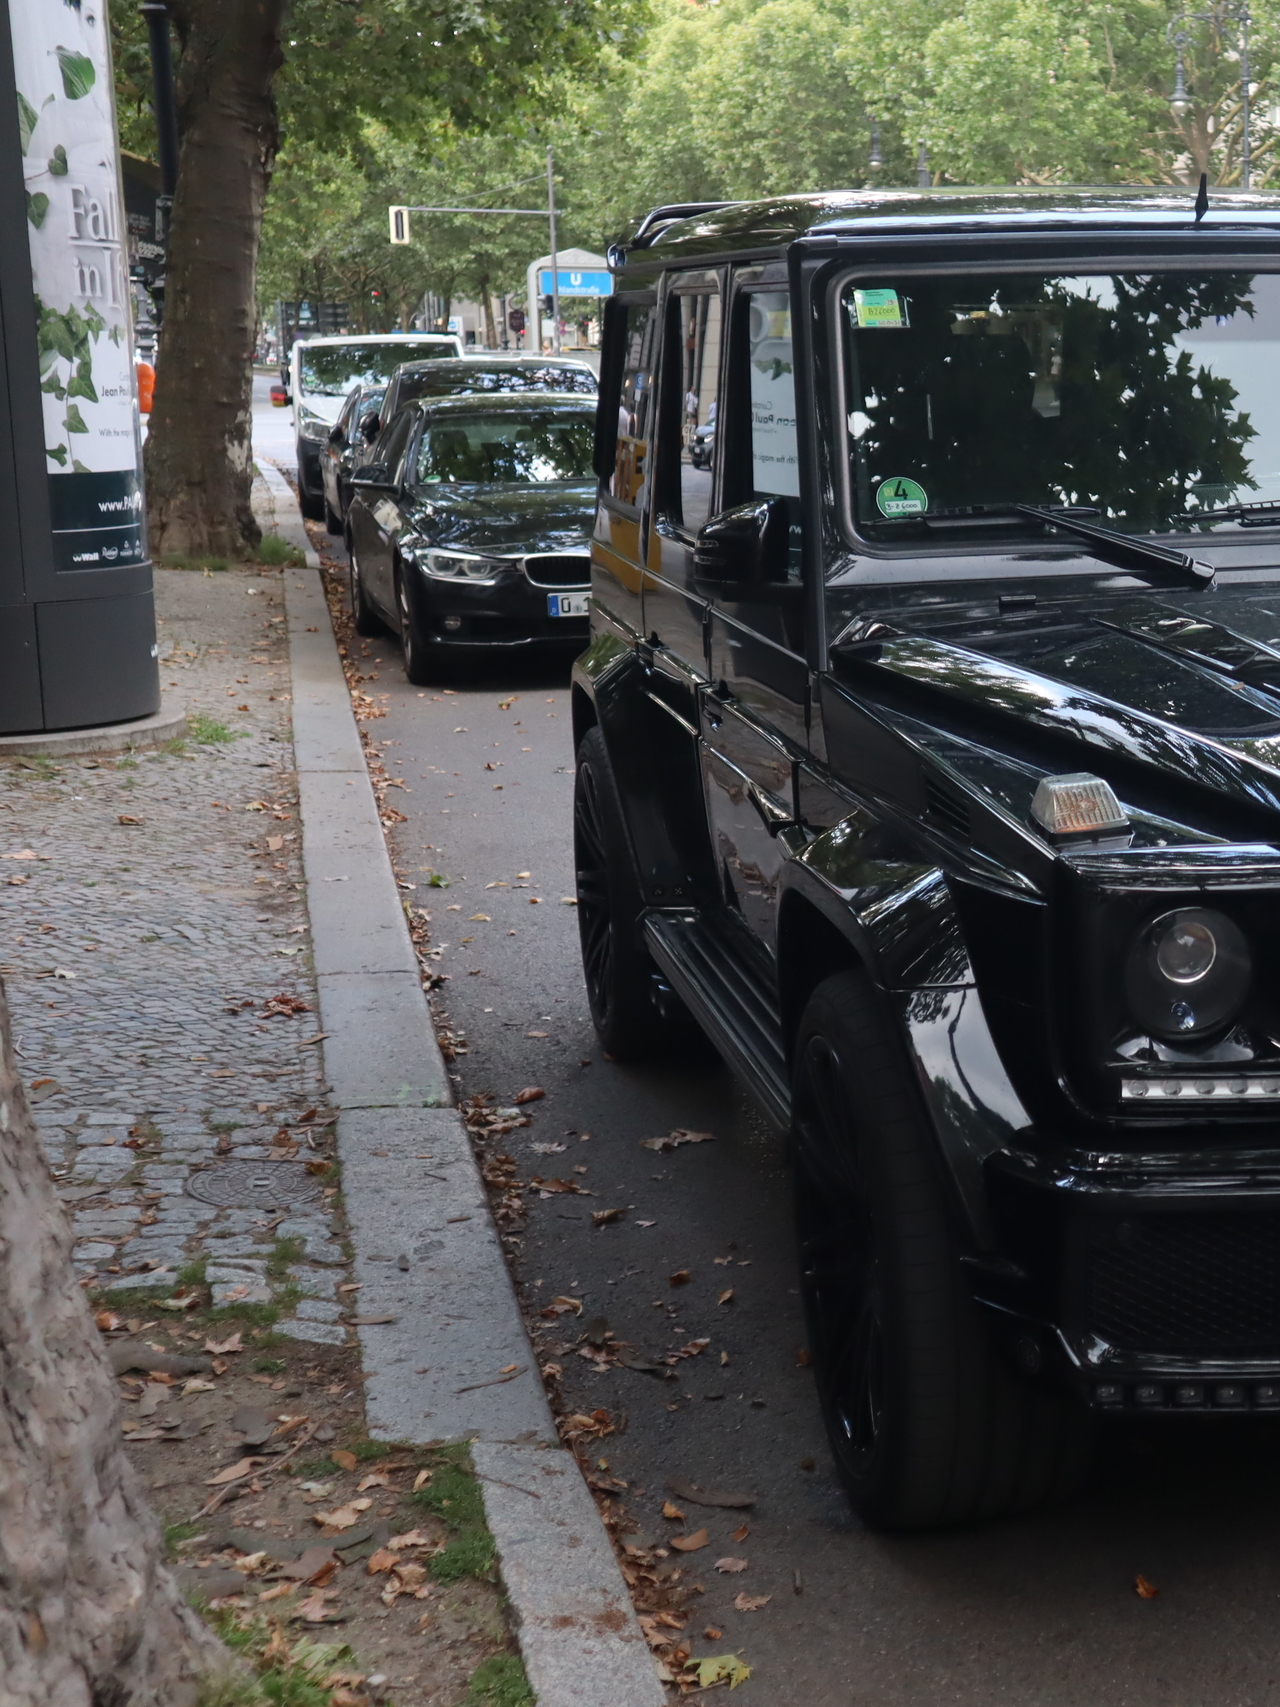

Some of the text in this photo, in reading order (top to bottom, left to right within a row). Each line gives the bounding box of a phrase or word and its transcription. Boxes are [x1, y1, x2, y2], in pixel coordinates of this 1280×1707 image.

[73, 255, 102, 297] in
[570, 272, 582, 286] U
[556, 285, 600, 294] hlandstraße
[101, 385, 118, 397] Jean
[894, 480, 908, 500] 4
